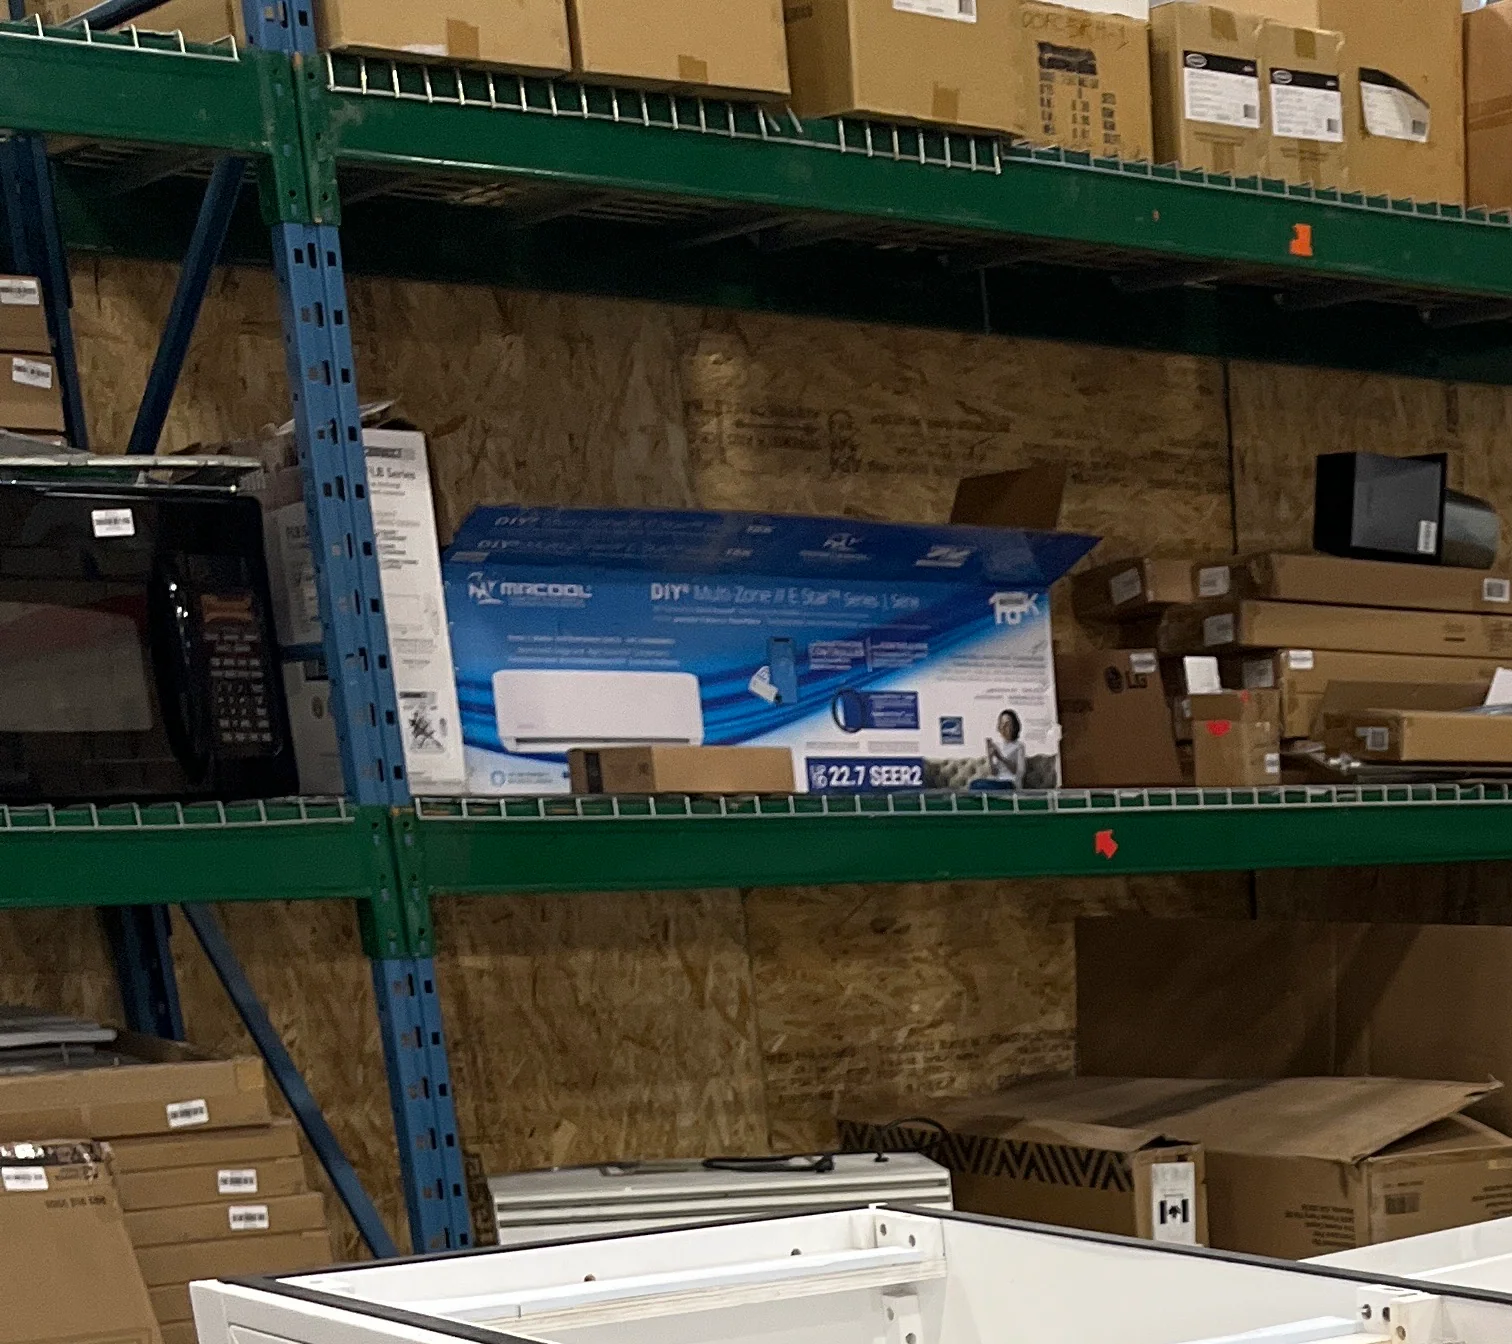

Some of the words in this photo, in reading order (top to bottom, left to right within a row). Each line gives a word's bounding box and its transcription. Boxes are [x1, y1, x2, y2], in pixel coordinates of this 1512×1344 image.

[1124, 670, 1148, 689] LG
[828, 765, 866, 787] 22.7
[869, 765, 923, 787] SEER2
